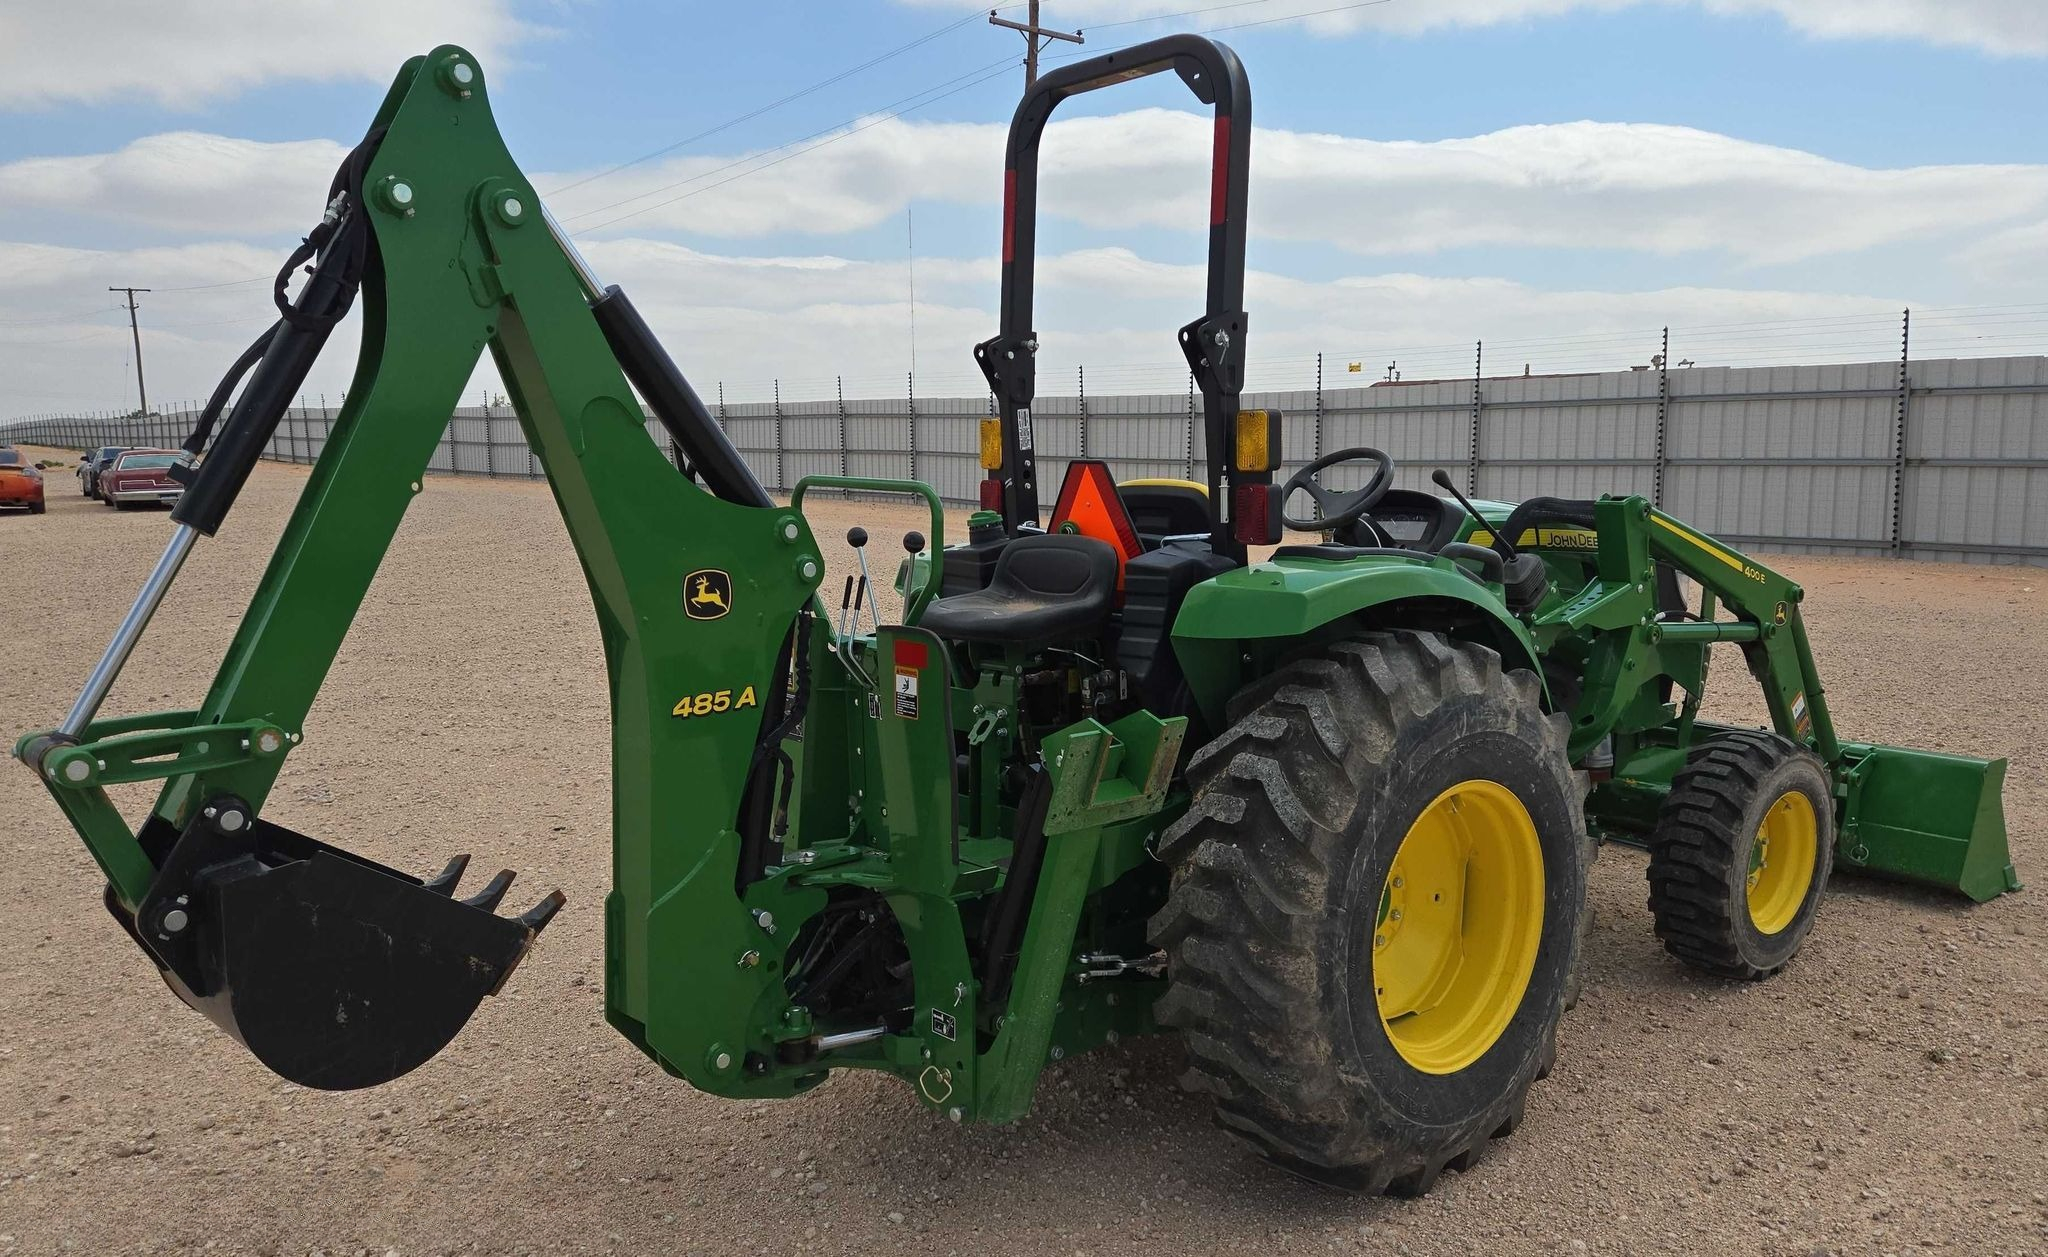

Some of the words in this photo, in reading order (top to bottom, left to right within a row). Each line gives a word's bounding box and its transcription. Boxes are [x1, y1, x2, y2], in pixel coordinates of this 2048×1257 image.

[1547, 532, 1578, 547] JOHN
[672, 689, 731, 718] 485
[734, 686, 757, 709] A
